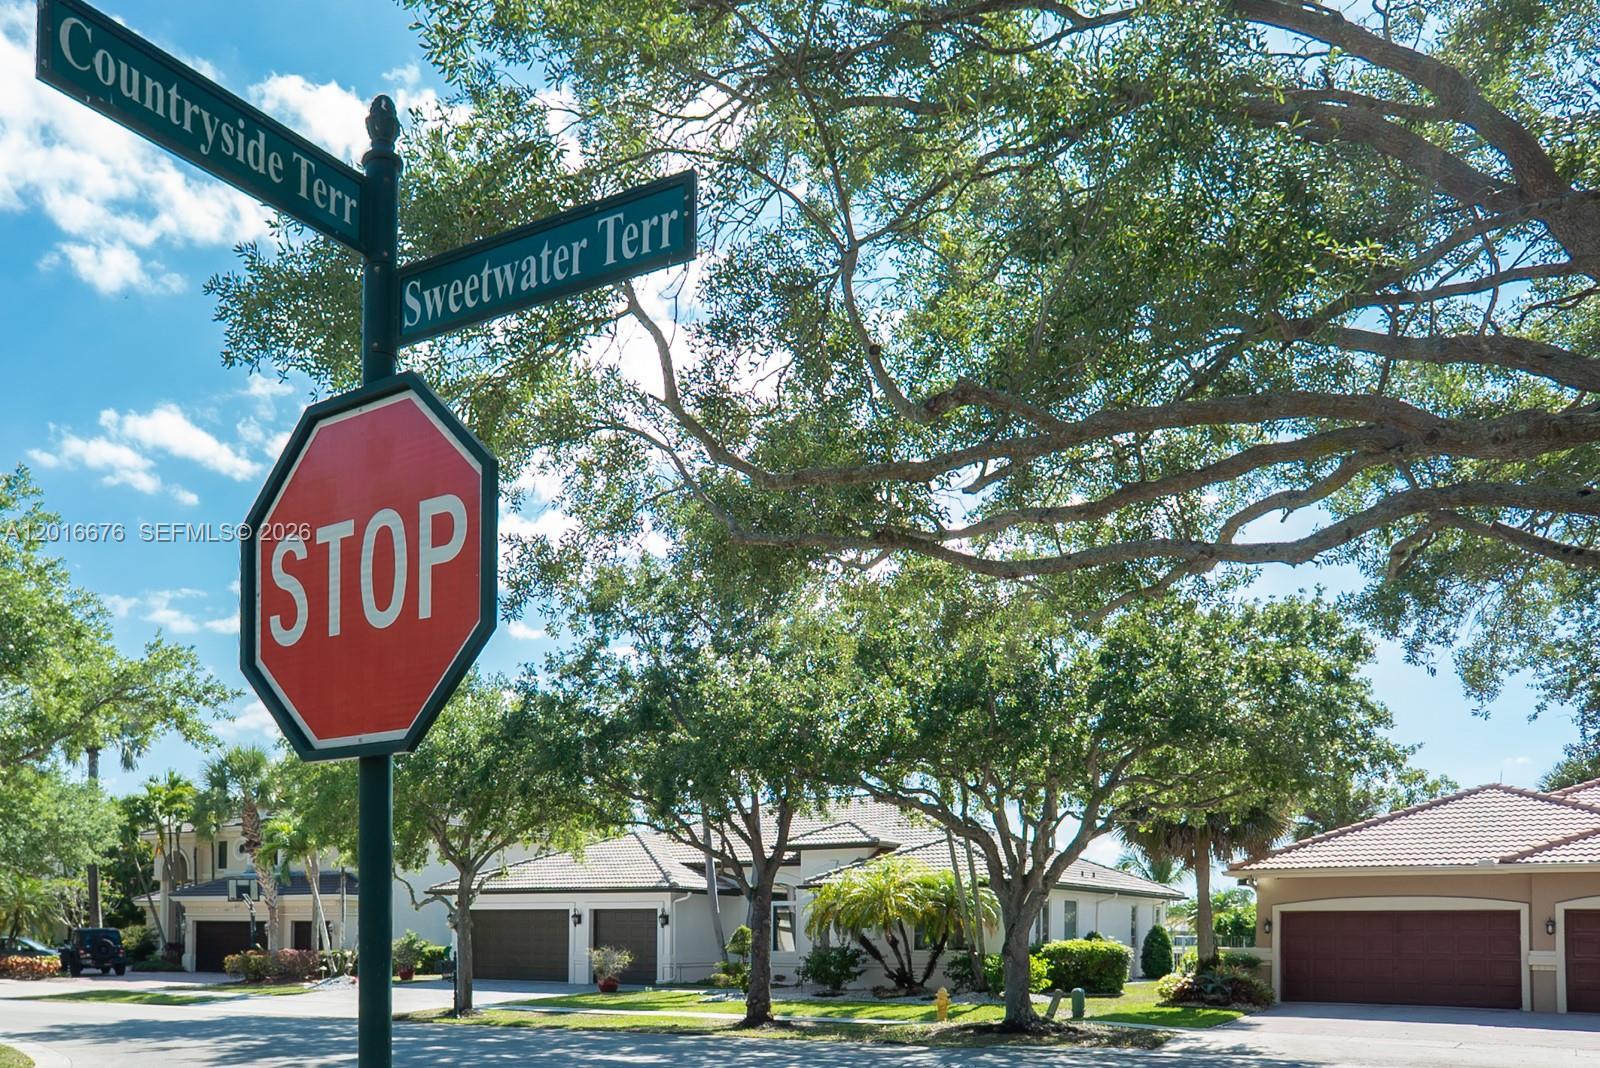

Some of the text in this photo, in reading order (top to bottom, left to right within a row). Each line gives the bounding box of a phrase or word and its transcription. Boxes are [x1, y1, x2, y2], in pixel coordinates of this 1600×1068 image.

[58, 17, 358, 226] Countryside Terr
[402, 207, 679, 329] Sweetwater Terr
[269, 494, 468, 647] STOP
